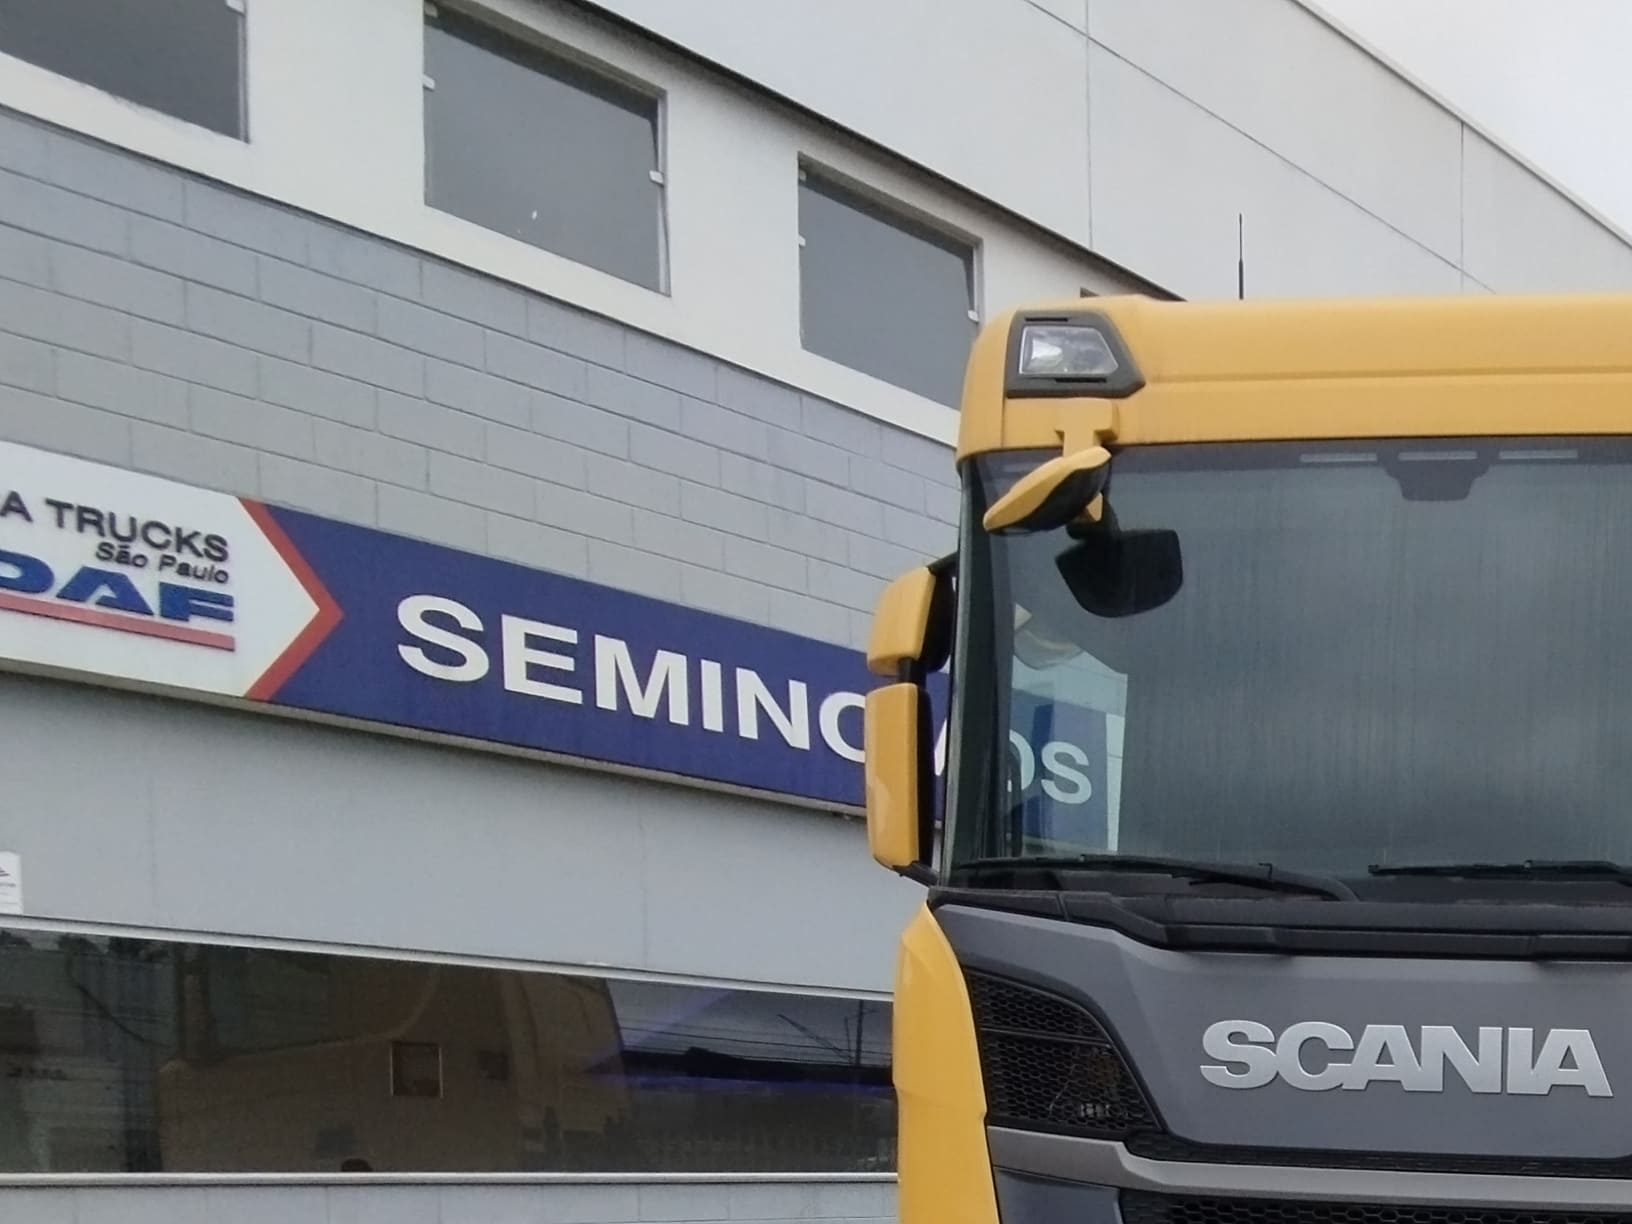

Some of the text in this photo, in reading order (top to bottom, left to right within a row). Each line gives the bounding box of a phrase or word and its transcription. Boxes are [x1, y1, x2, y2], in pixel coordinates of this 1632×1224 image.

[45, 497, 230, 562] TRUCKS
[95, 541, 229, 584] São Paulo
[1200, 1019, 1613, 1097] SCANIA
